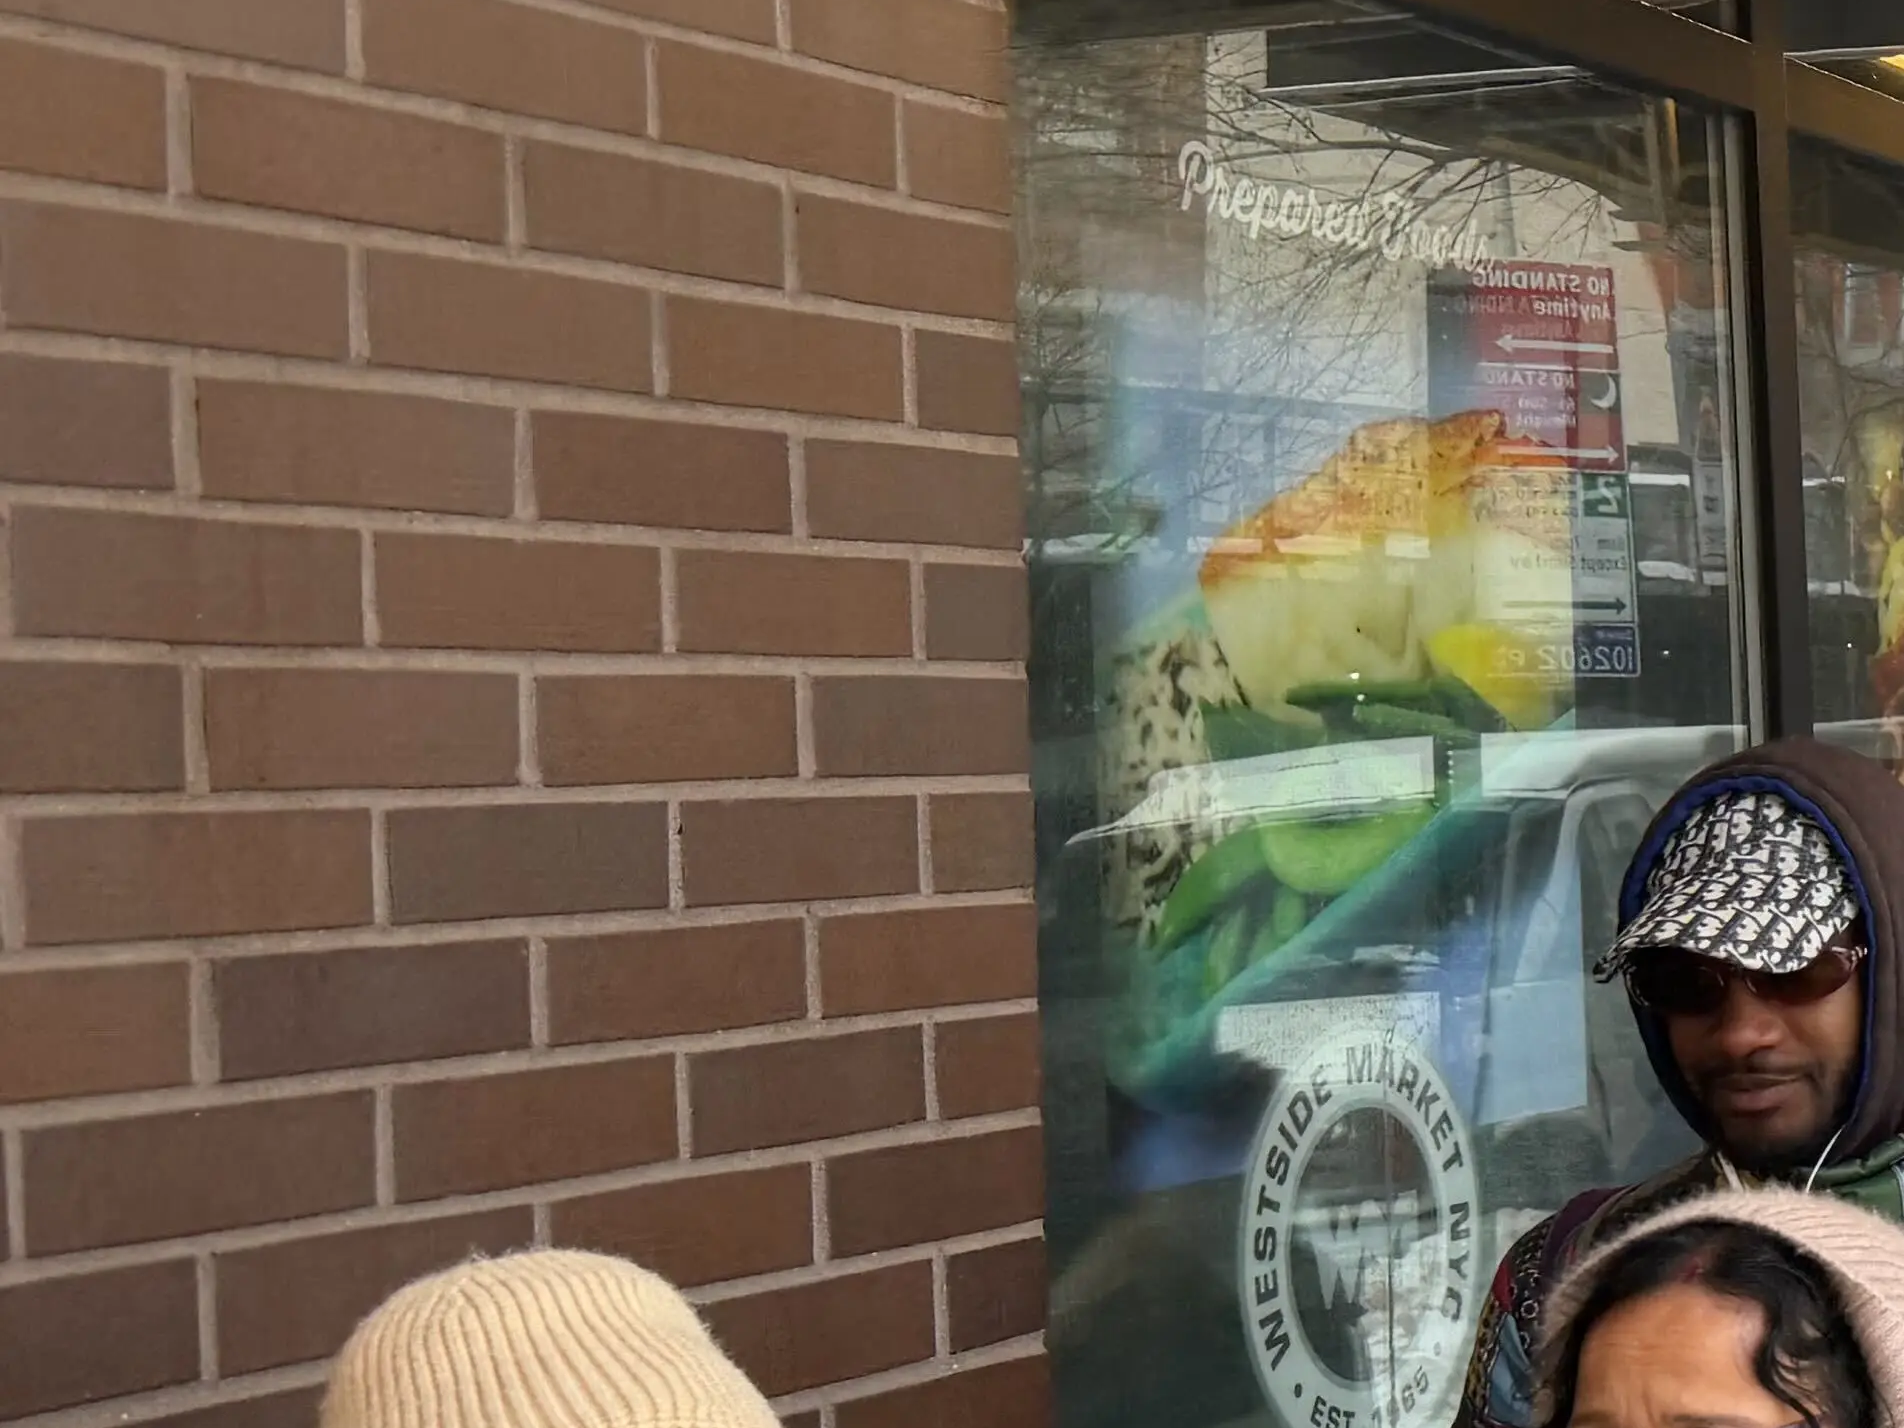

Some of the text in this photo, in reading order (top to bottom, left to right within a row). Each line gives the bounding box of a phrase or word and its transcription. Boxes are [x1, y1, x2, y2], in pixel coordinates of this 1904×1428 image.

[1178, 140, 1372, 249] Prepared
[1253, 1043, 1472, 1372] WESTSIDE MARKET NYC
